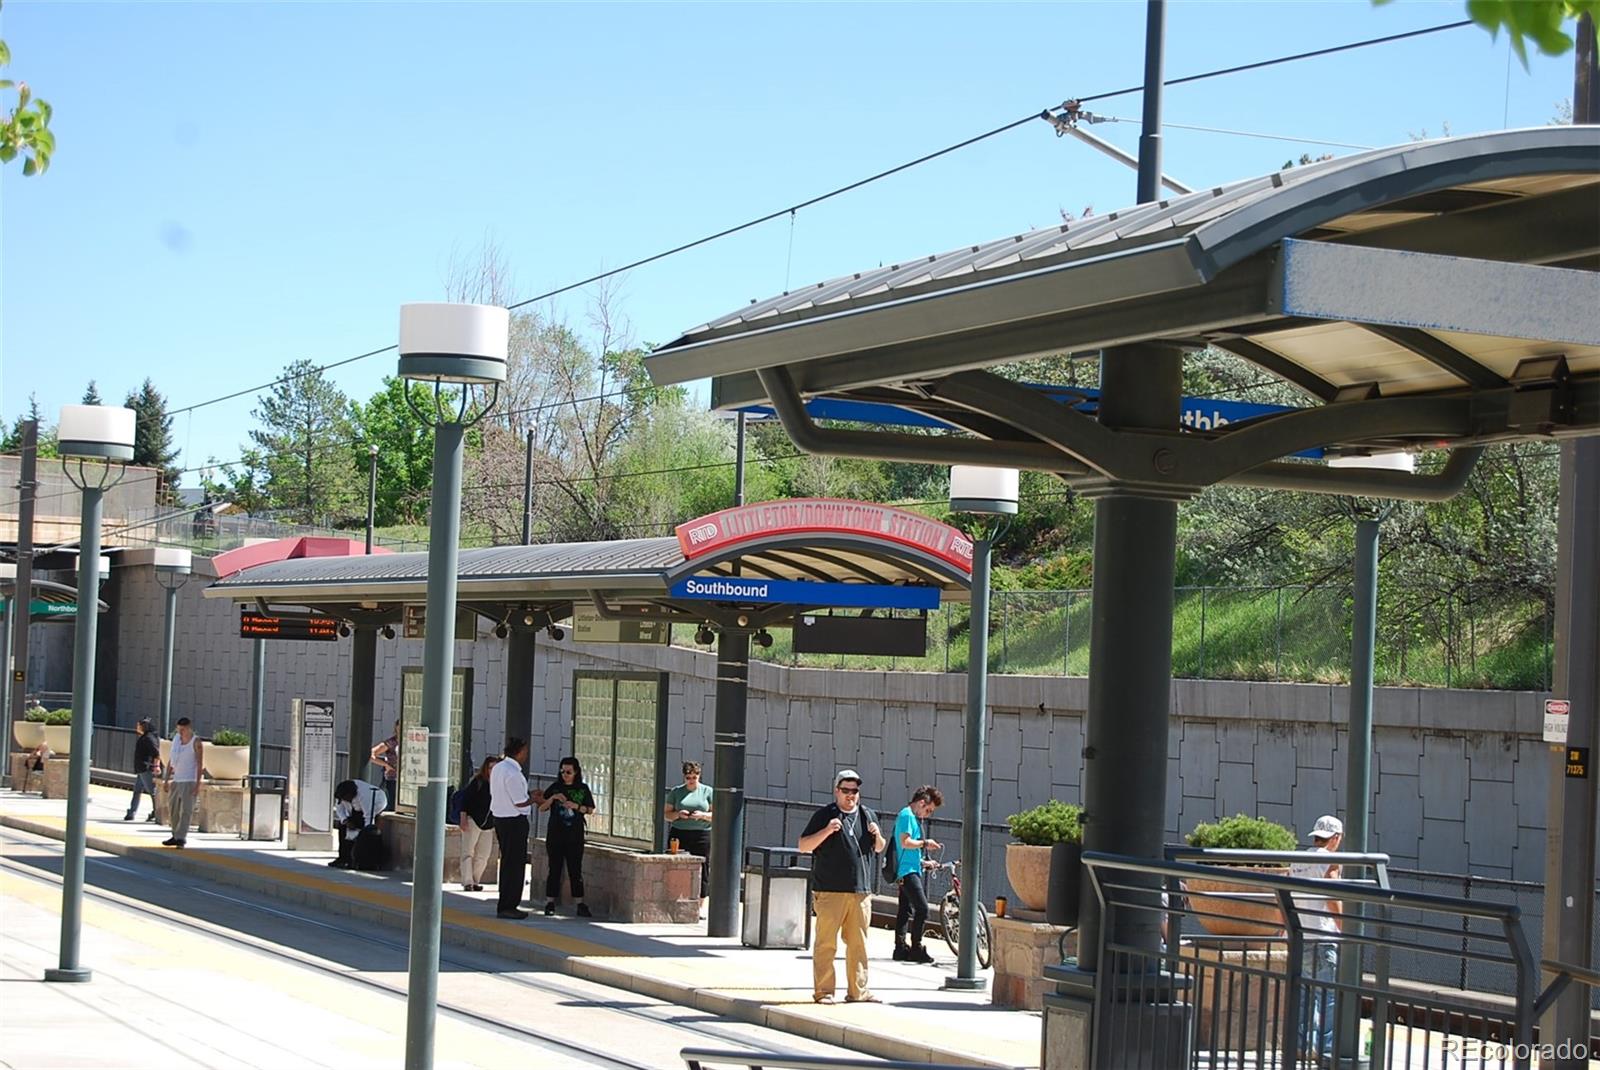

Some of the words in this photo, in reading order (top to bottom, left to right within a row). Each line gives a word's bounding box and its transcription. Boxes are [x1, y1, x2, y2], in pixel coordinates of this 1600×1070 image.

[688, 522, 718, 545] RTD
[888, 512, 944, 548] STATION
[686, 580, 768, 597] Southbound
